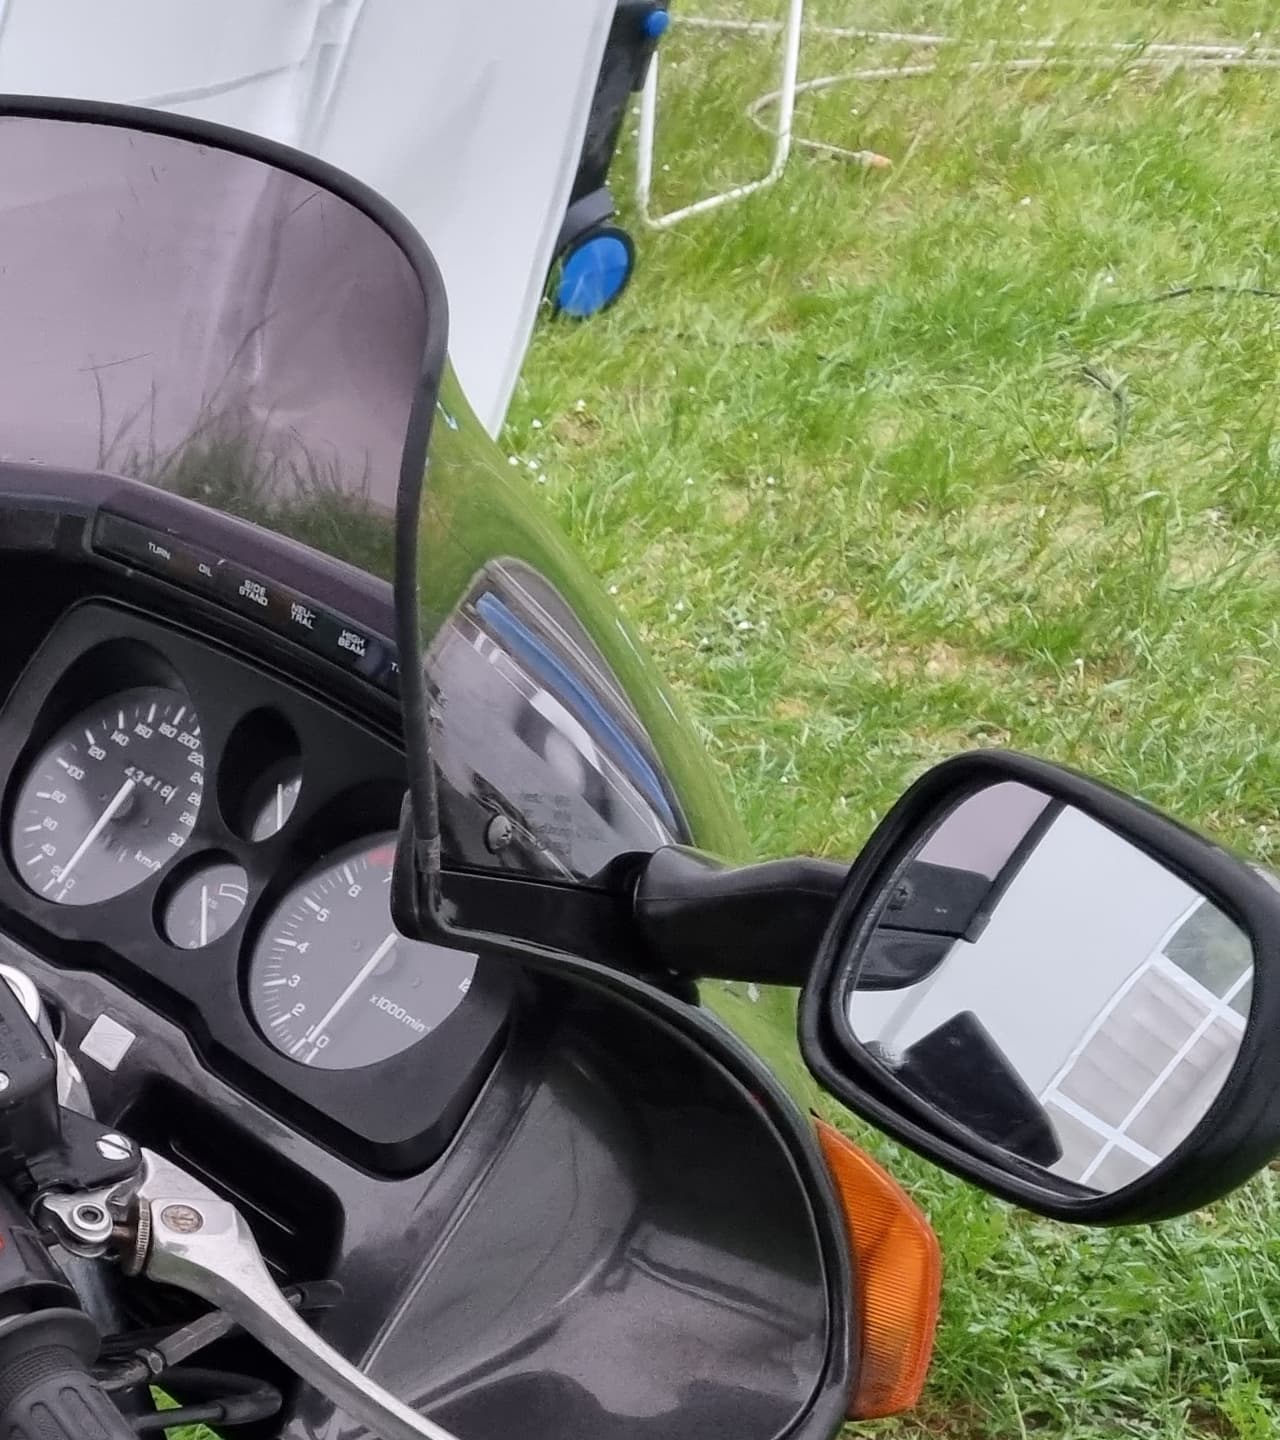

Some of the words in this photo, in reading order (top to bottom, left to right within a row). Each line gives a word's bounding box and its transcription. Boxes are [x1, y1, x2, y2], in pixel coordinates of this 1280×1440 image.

[148, 542, 171, 560] TURN
[198, 563, 212, 577] OIL
[244, 580, 266, 596] SIDE
[239, 586, 268, 606] STAND
[342, 629, 365, 647] HIGH
[337, 636, 365, 657] BEAM
[110, 730, 130, 747] 140
[177, 732, 201, 750] 200
[88, 745, 106, 761] 120
[67, 764, 86, 781] 100
[41, 843, 56, 857] 40
[64, 878, 76, 890] 0
[348, 884, 362, 898] 6
[317, 908, 330, 922] 5
[296, 942, 310, 954] 4
[288, 974, 300, 987] 3
[291, 1003, 306, 1016] 2
[316, 1035, 330, 1049] 0
